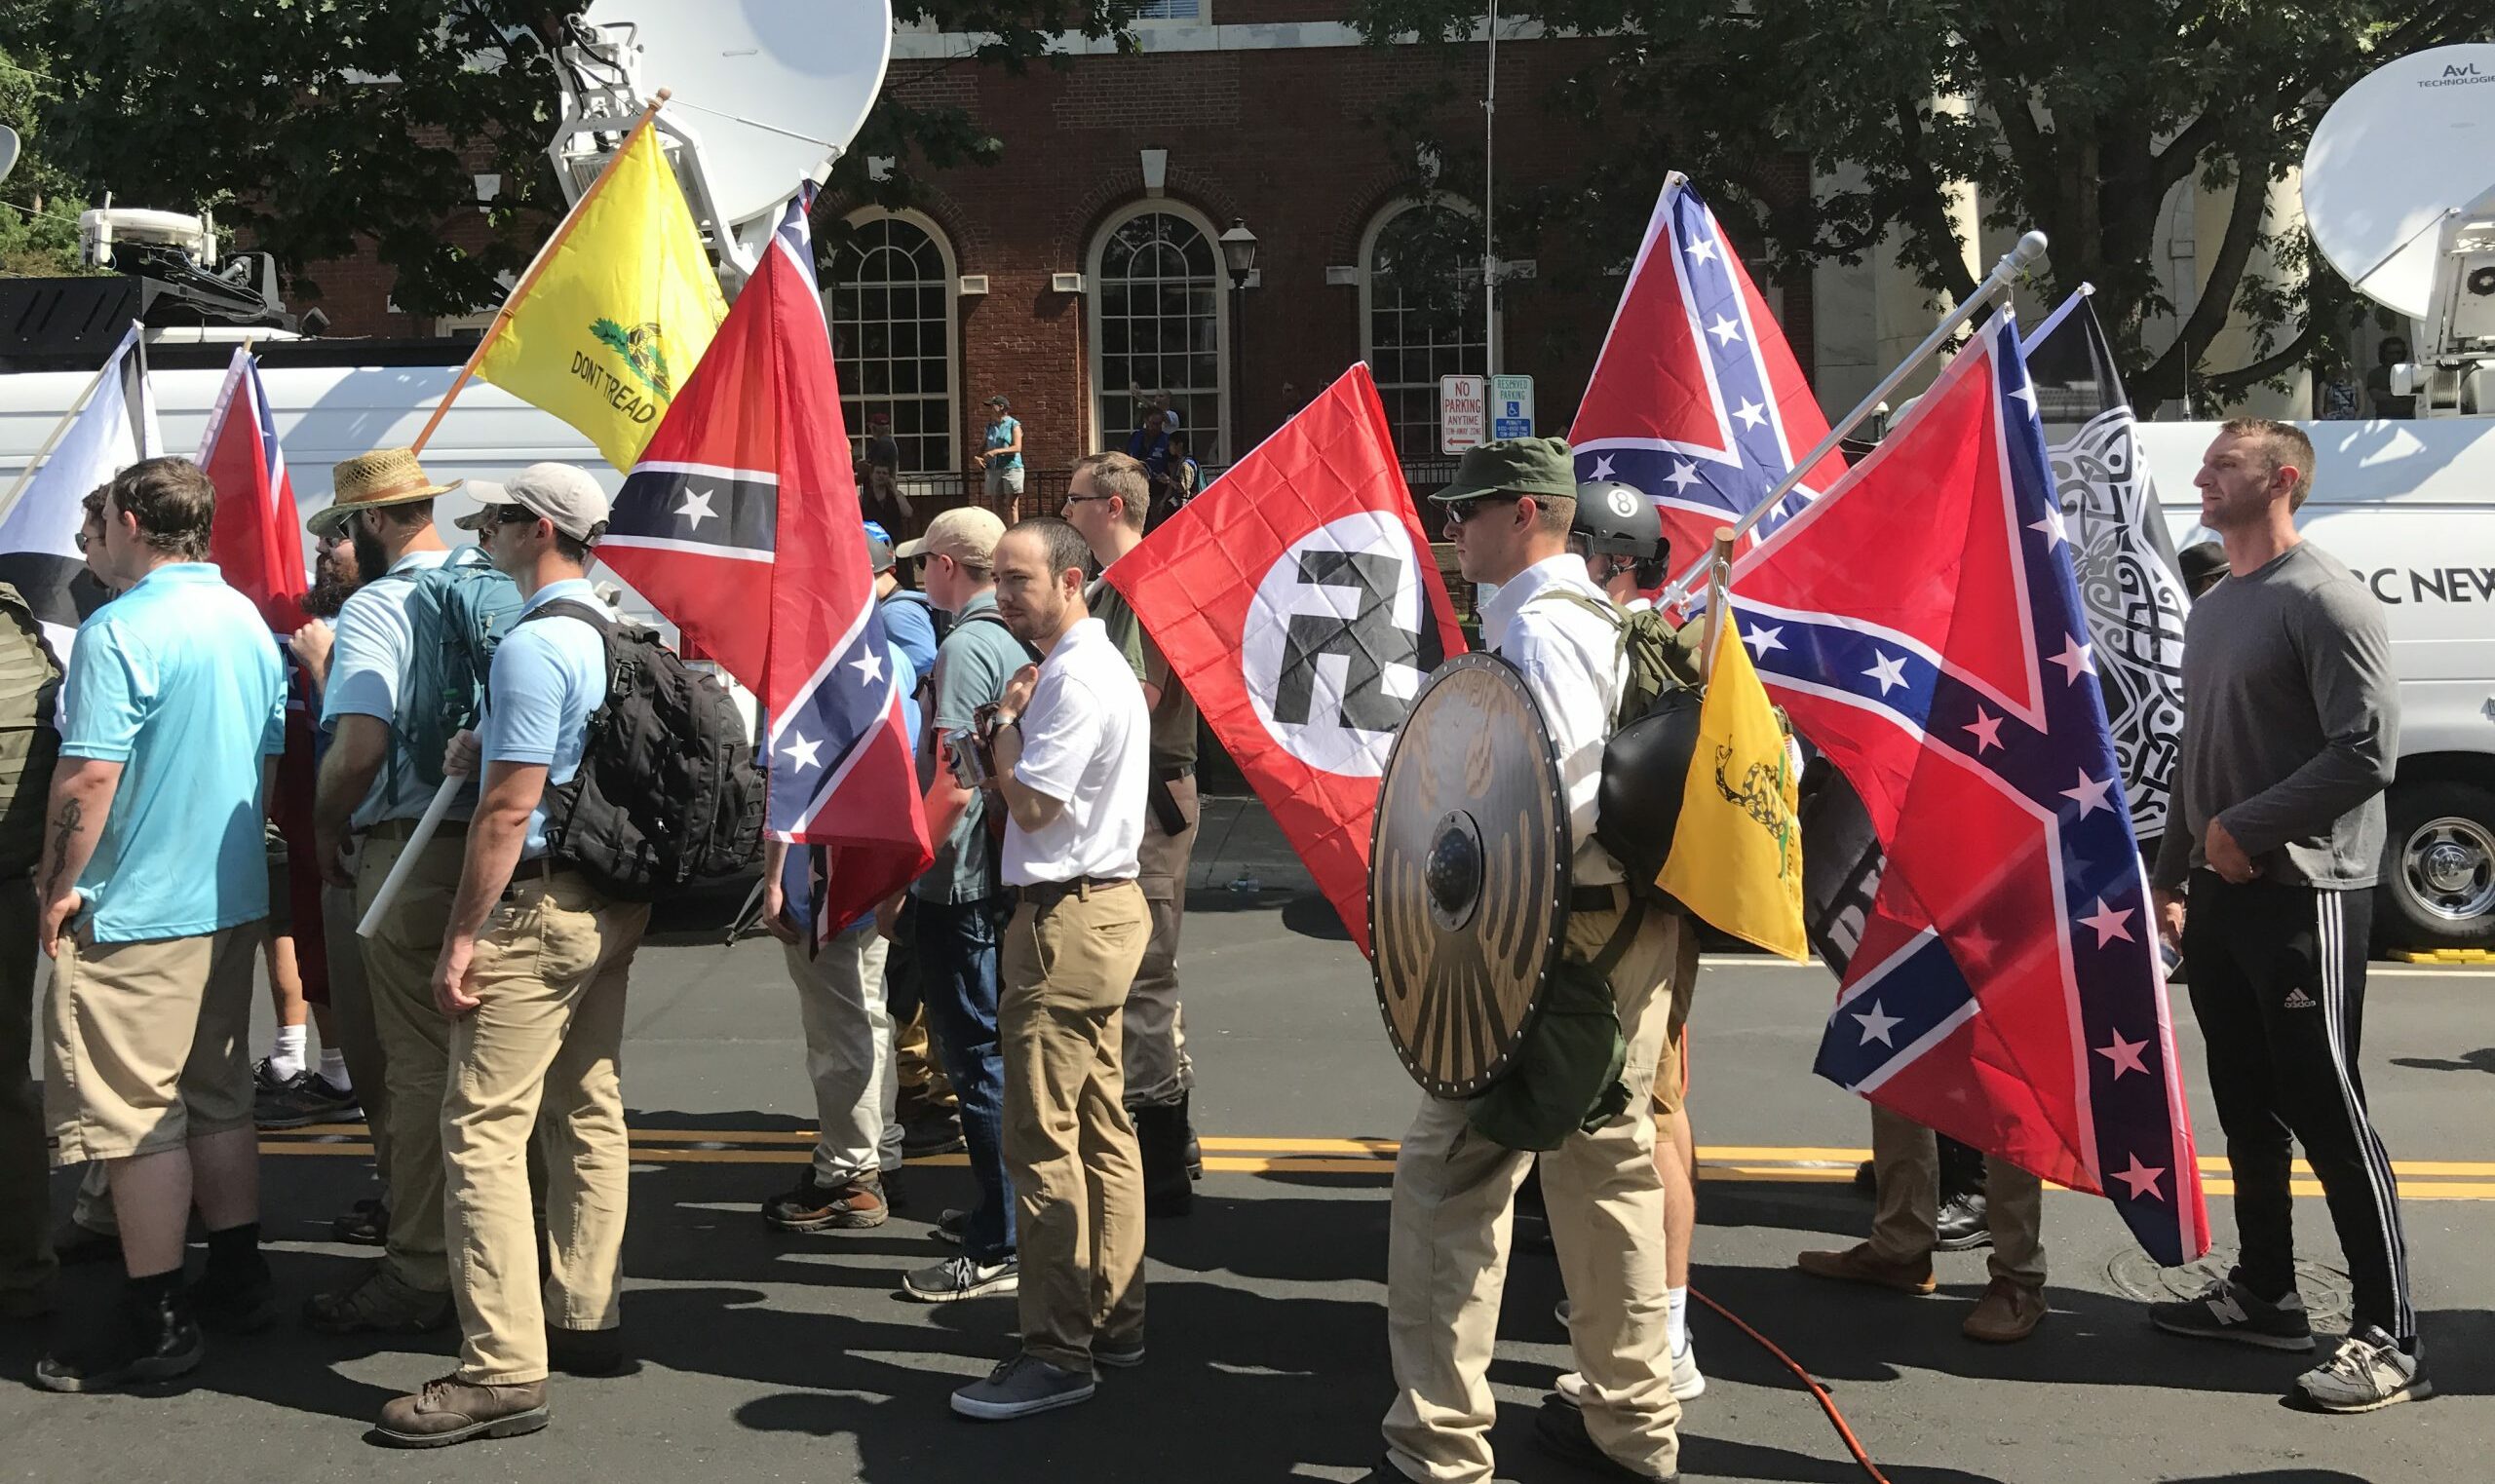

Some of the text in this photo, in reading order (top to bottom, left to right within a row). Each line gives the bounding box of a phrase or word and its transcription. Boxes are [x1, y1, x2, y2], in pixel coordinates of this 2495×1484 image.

[2442, 62, 2481, 77] AvL
[571, 350, 656, 423] DONT TREAD
[1455, 382, 1470, 397] NO
[1497, 379, 1527, 389] RESERVED
[1500, 390, 1525, 400] PARKING
[1445, 399, 1480, 413] PARKING
[1448, 416, 1478, 425] ANYTIME
[1616, 491, 1631, 514] 8
[2349, 568, 2401, 604] C
